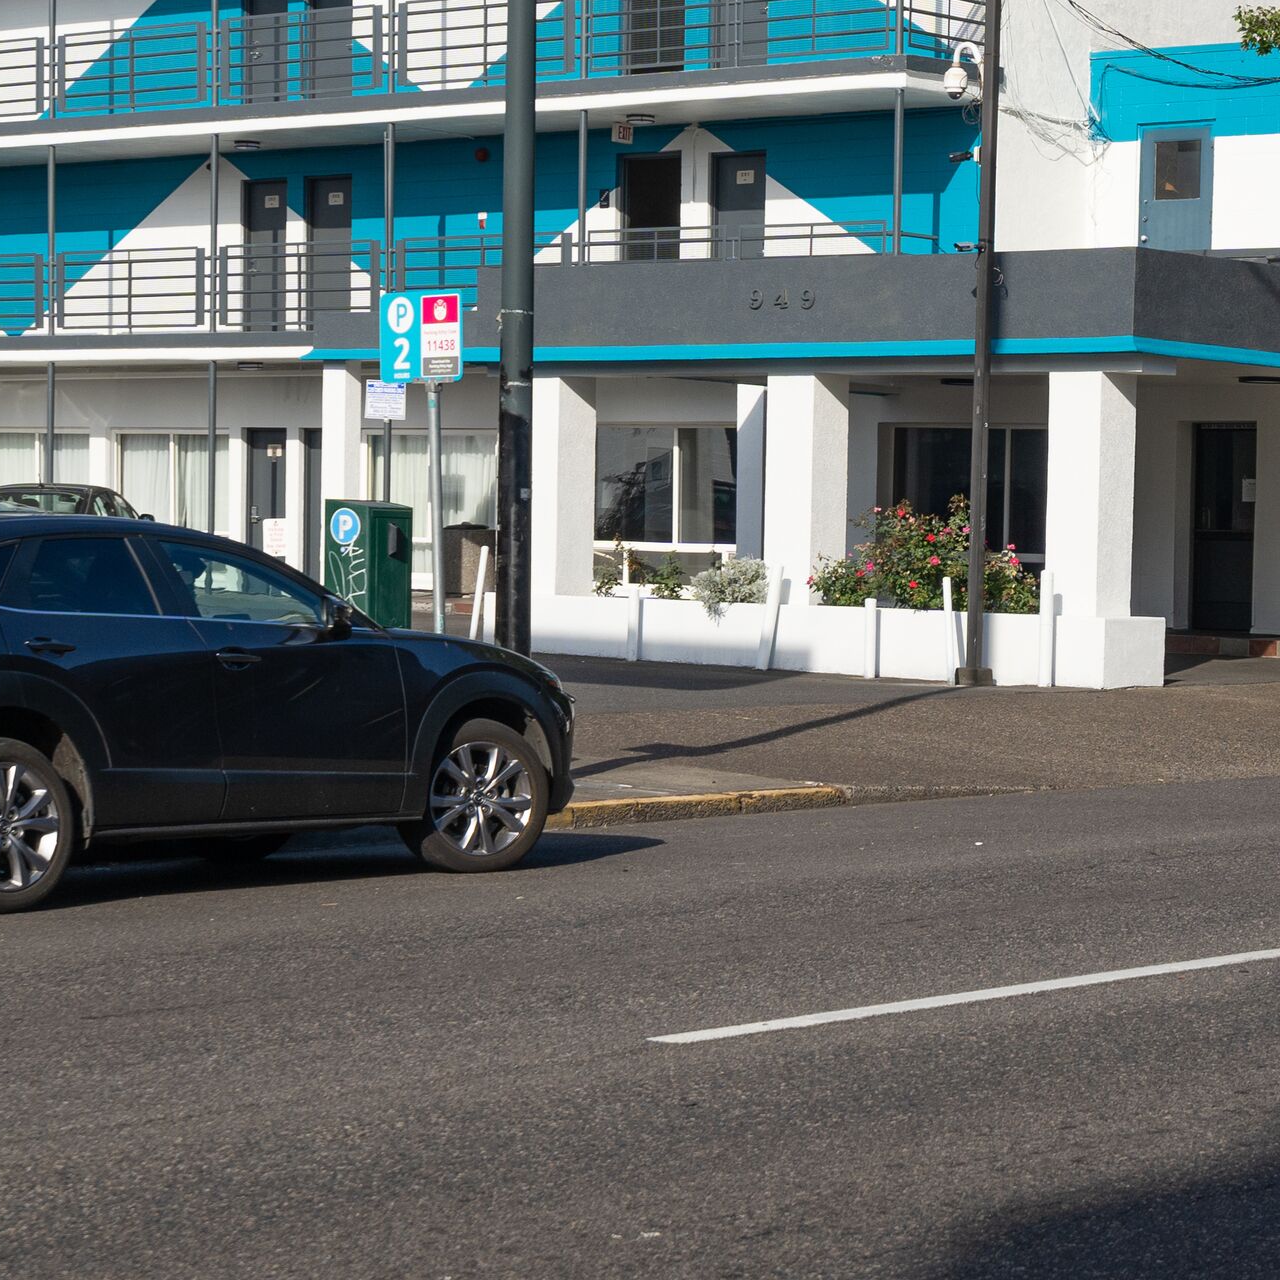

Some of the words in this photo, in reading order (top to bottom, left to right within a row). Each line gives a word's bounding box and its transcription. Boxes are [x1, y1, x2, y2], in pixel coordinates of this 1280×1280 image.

[618, 125, 631, 141] EXIT
[749, 288, 816, 310] 949
[396, 303, 408, 328] P
[393, 337, 411, 370] 2
[427, 339, 456, 352] 11438
[338, 514, 353, 539] P
